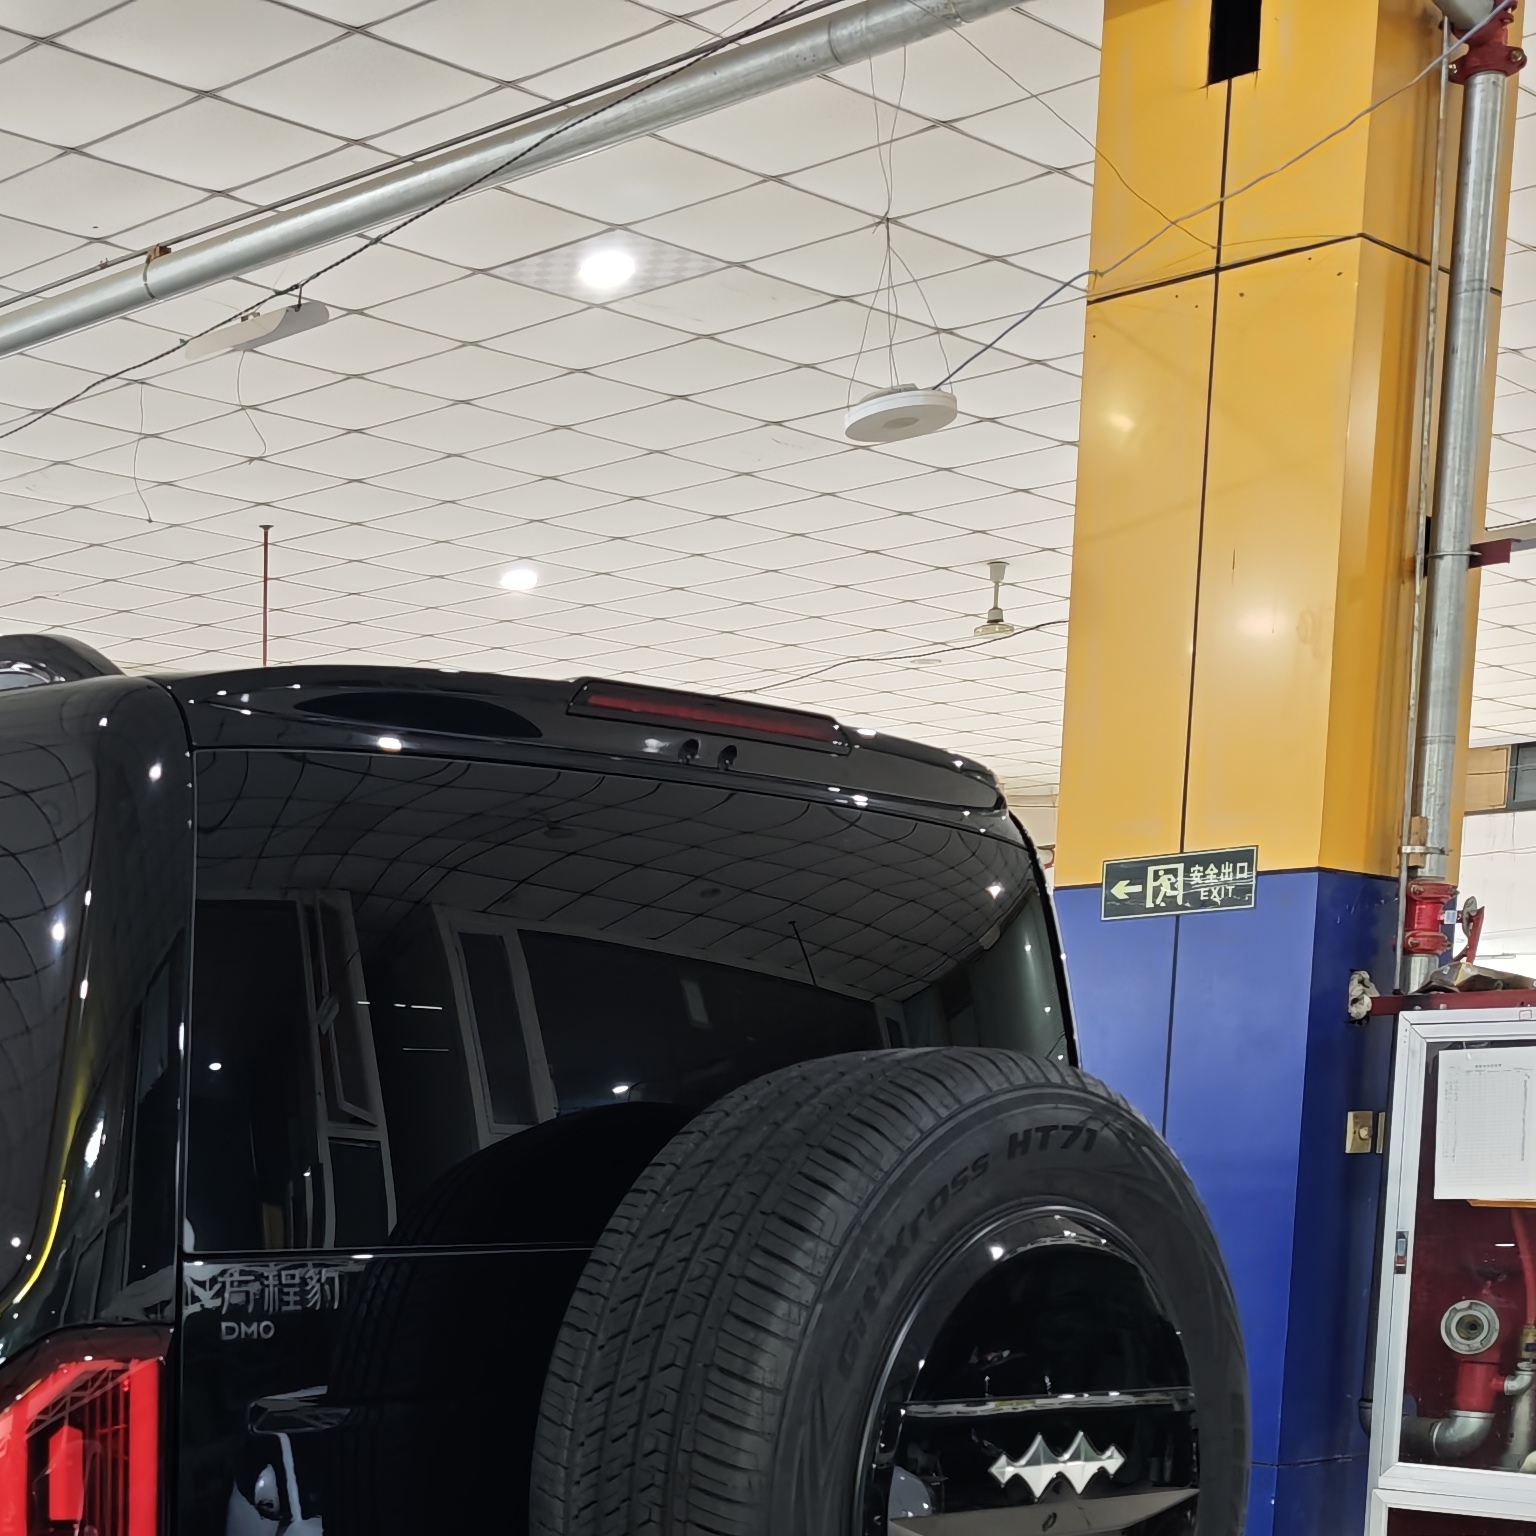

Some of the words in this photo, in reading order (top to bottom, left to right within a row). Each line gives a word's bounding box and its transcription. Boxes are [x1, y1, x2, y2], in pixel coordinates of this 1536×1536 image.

[1190, 861, 1248, 884] 安全出口
[1200, 885, 1236, 901] EXIT
[1006, 1123, 1100, 1161] HT71
[217, 1267, 342, 1315] 方程豹
[220, 1320, 276, 1341] DMO
